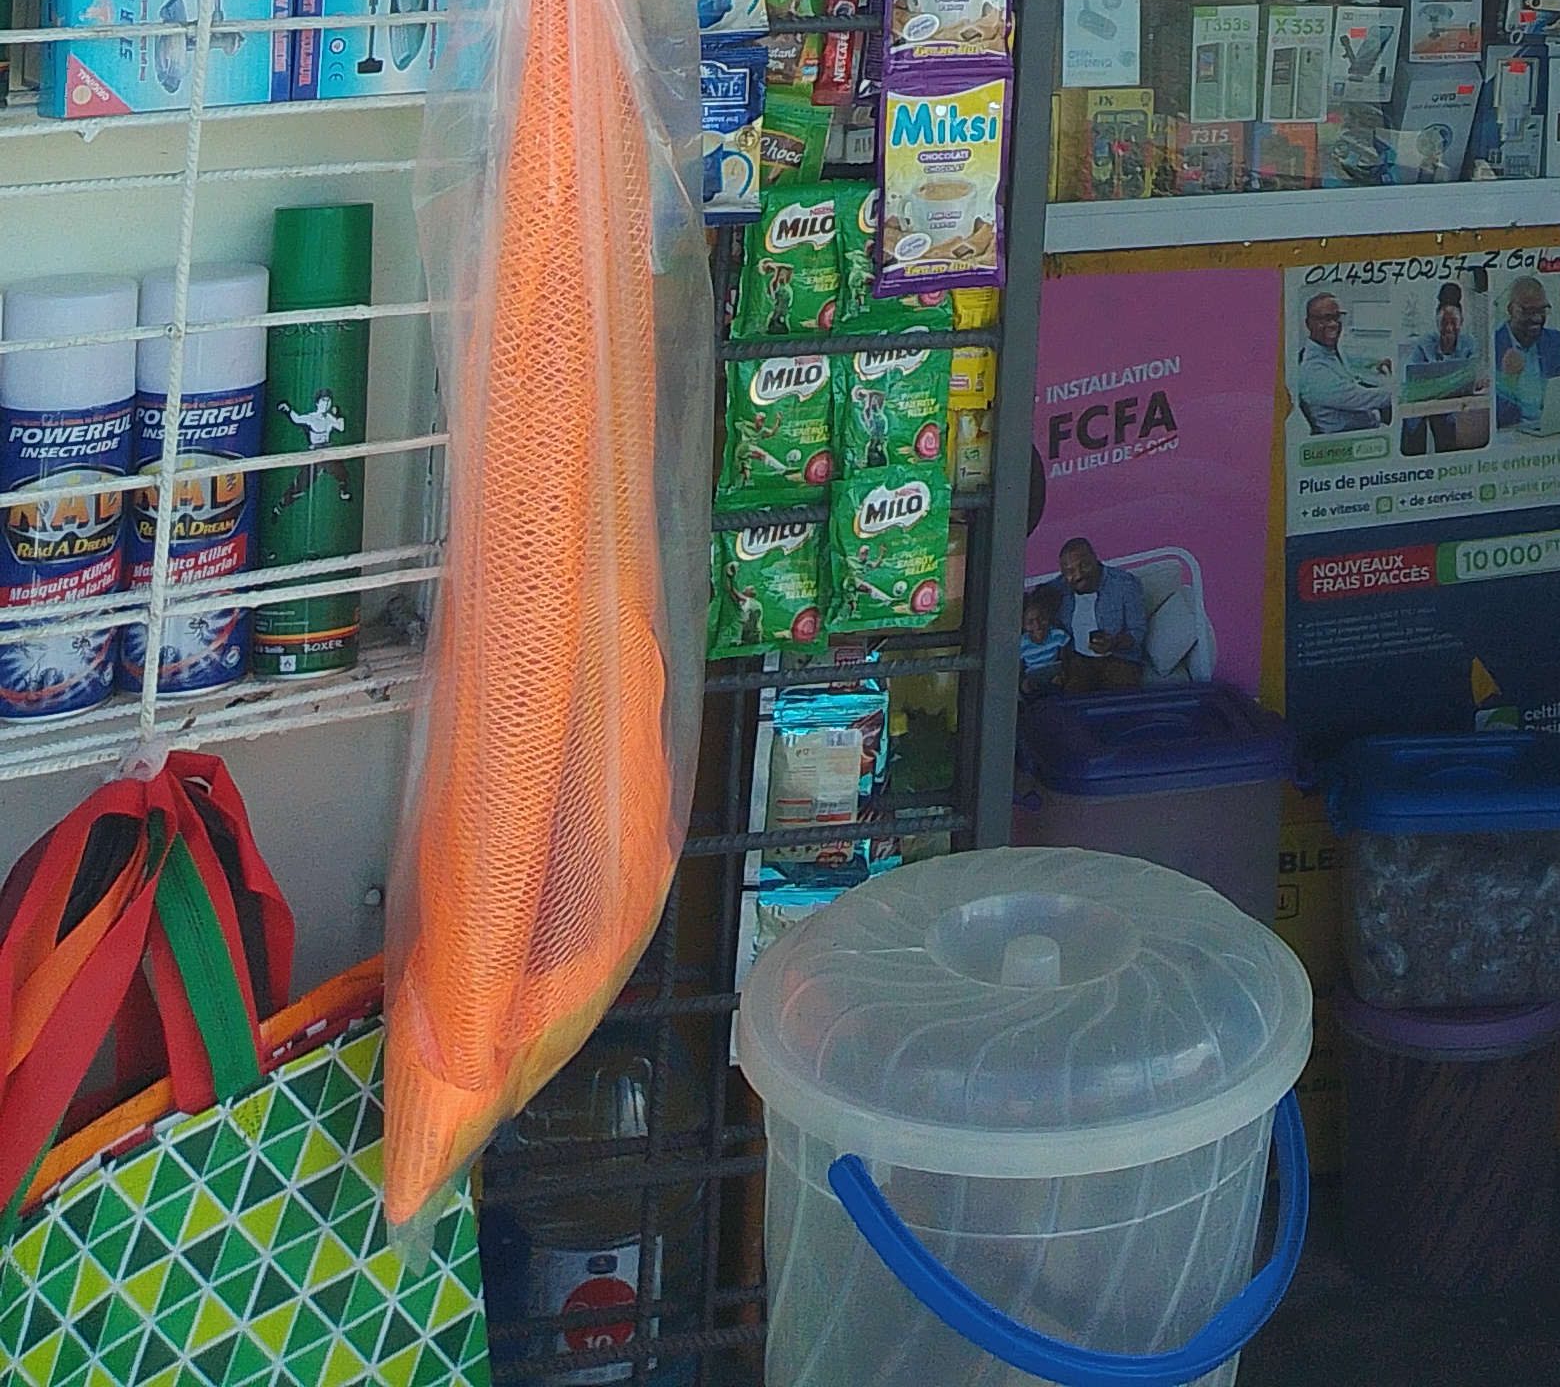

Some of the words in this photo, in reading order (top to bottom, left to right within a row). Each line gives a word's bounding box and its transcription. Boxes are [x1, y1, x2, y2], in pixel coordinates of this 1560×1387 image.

[77, 68, 110, 102] ORIGINAL
[891, 102, 998, 147] Miksi
[919, 150, 970, 162] CHOCOLATE
[776, 215, 835, 242] MILO
[761, 364, 823, 393] MILO
[1046, 355, 1181, 405] INSTALLATION
[9, 413, 132, 444] POWERFUL
[1048, 390, 1178, 461] FCFA
[20, 436, 121, 459] INSECTICIDE
[1050, 459, 1074, 478] AU
[1077, 450, 1110, 471] LIEU
[1112, 443, 1133, 464] DE
[1299, 476, 1332, 495] Plus
[1335, 472, 1356, 490] de
[1359, 466, 1435, 492] puissance
[1437, 461, 1473, 482] pour
[865, 495, 923, 525] MILO
[1311, 504, 1327, 518] de
[1329, 501, 1371, 517] vitesse
[1408, 493, 1425, 507] de
[1426, 488, 1474, 506] services
[57, 539, 70, 555] A
[197, 541, 236, 565] Killer
[1313, 553, 1405, 578] NOUVEAUX
[1462, 550, 1488, 573] 10
[1492, 544, 1542, 568] 000
[9, 577, 79, 601] Mosquito
[81, 557, 115, 583] Killer
[1313, 576, 1360, 595] FRAIS
[1364, 565, 1431, 589] D'ACCÈS
[302, 638, 345, 654] BOXER
